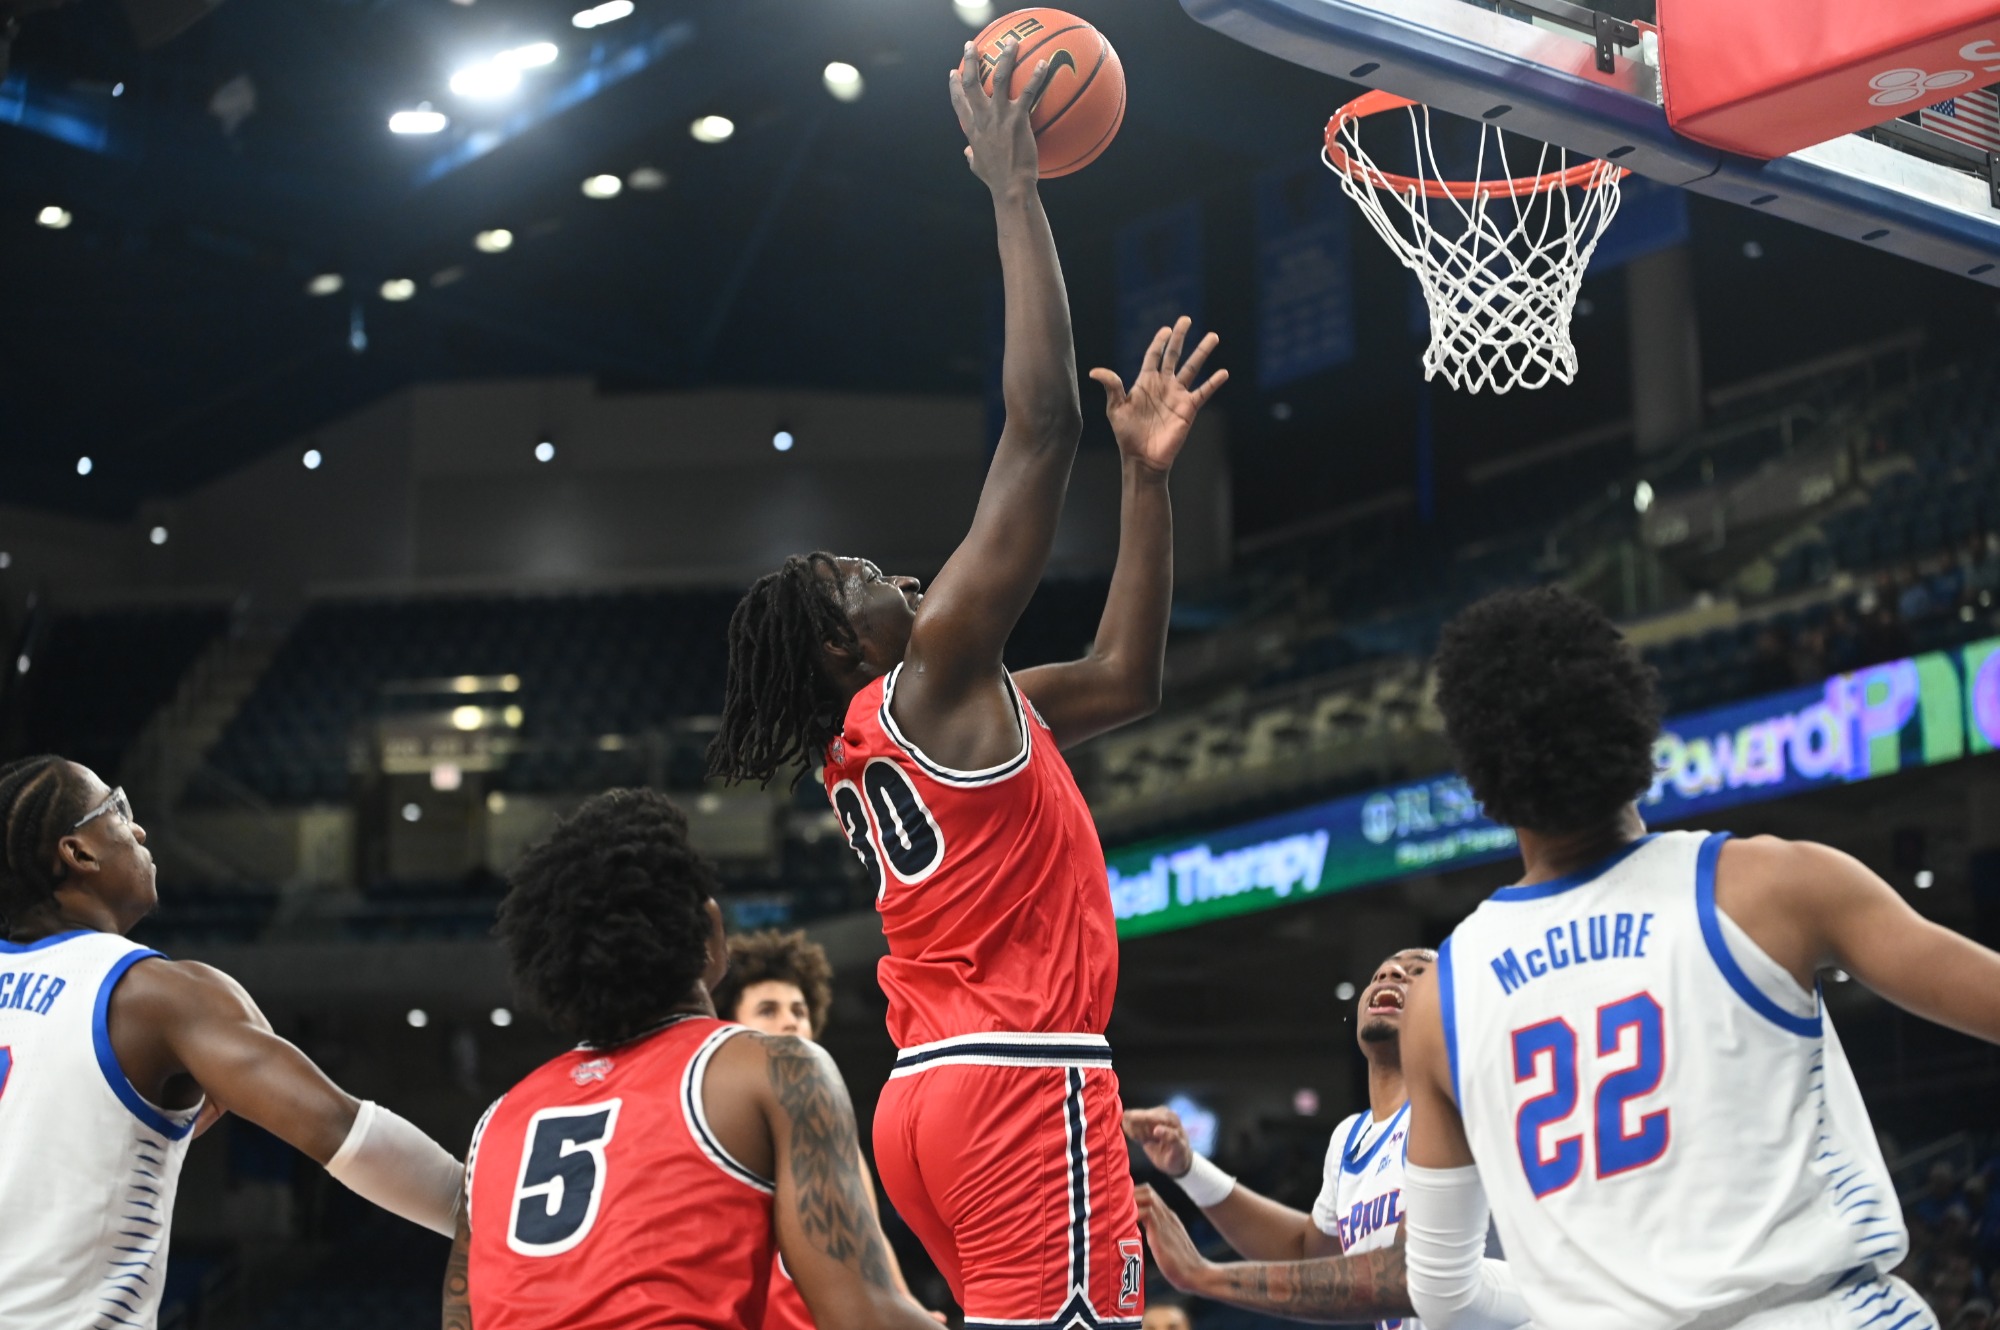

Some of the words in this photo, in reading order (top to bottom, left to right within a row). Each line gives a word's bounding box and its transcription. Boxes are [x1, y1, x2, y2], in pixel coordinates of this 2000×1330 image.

[1168, 828, 1331, 907] Therapy
[1490, 913, 1655, 997] McCLURE
[1511, 989, 1670, 1202] 22
[506, 1096, 623, 1258] 5
